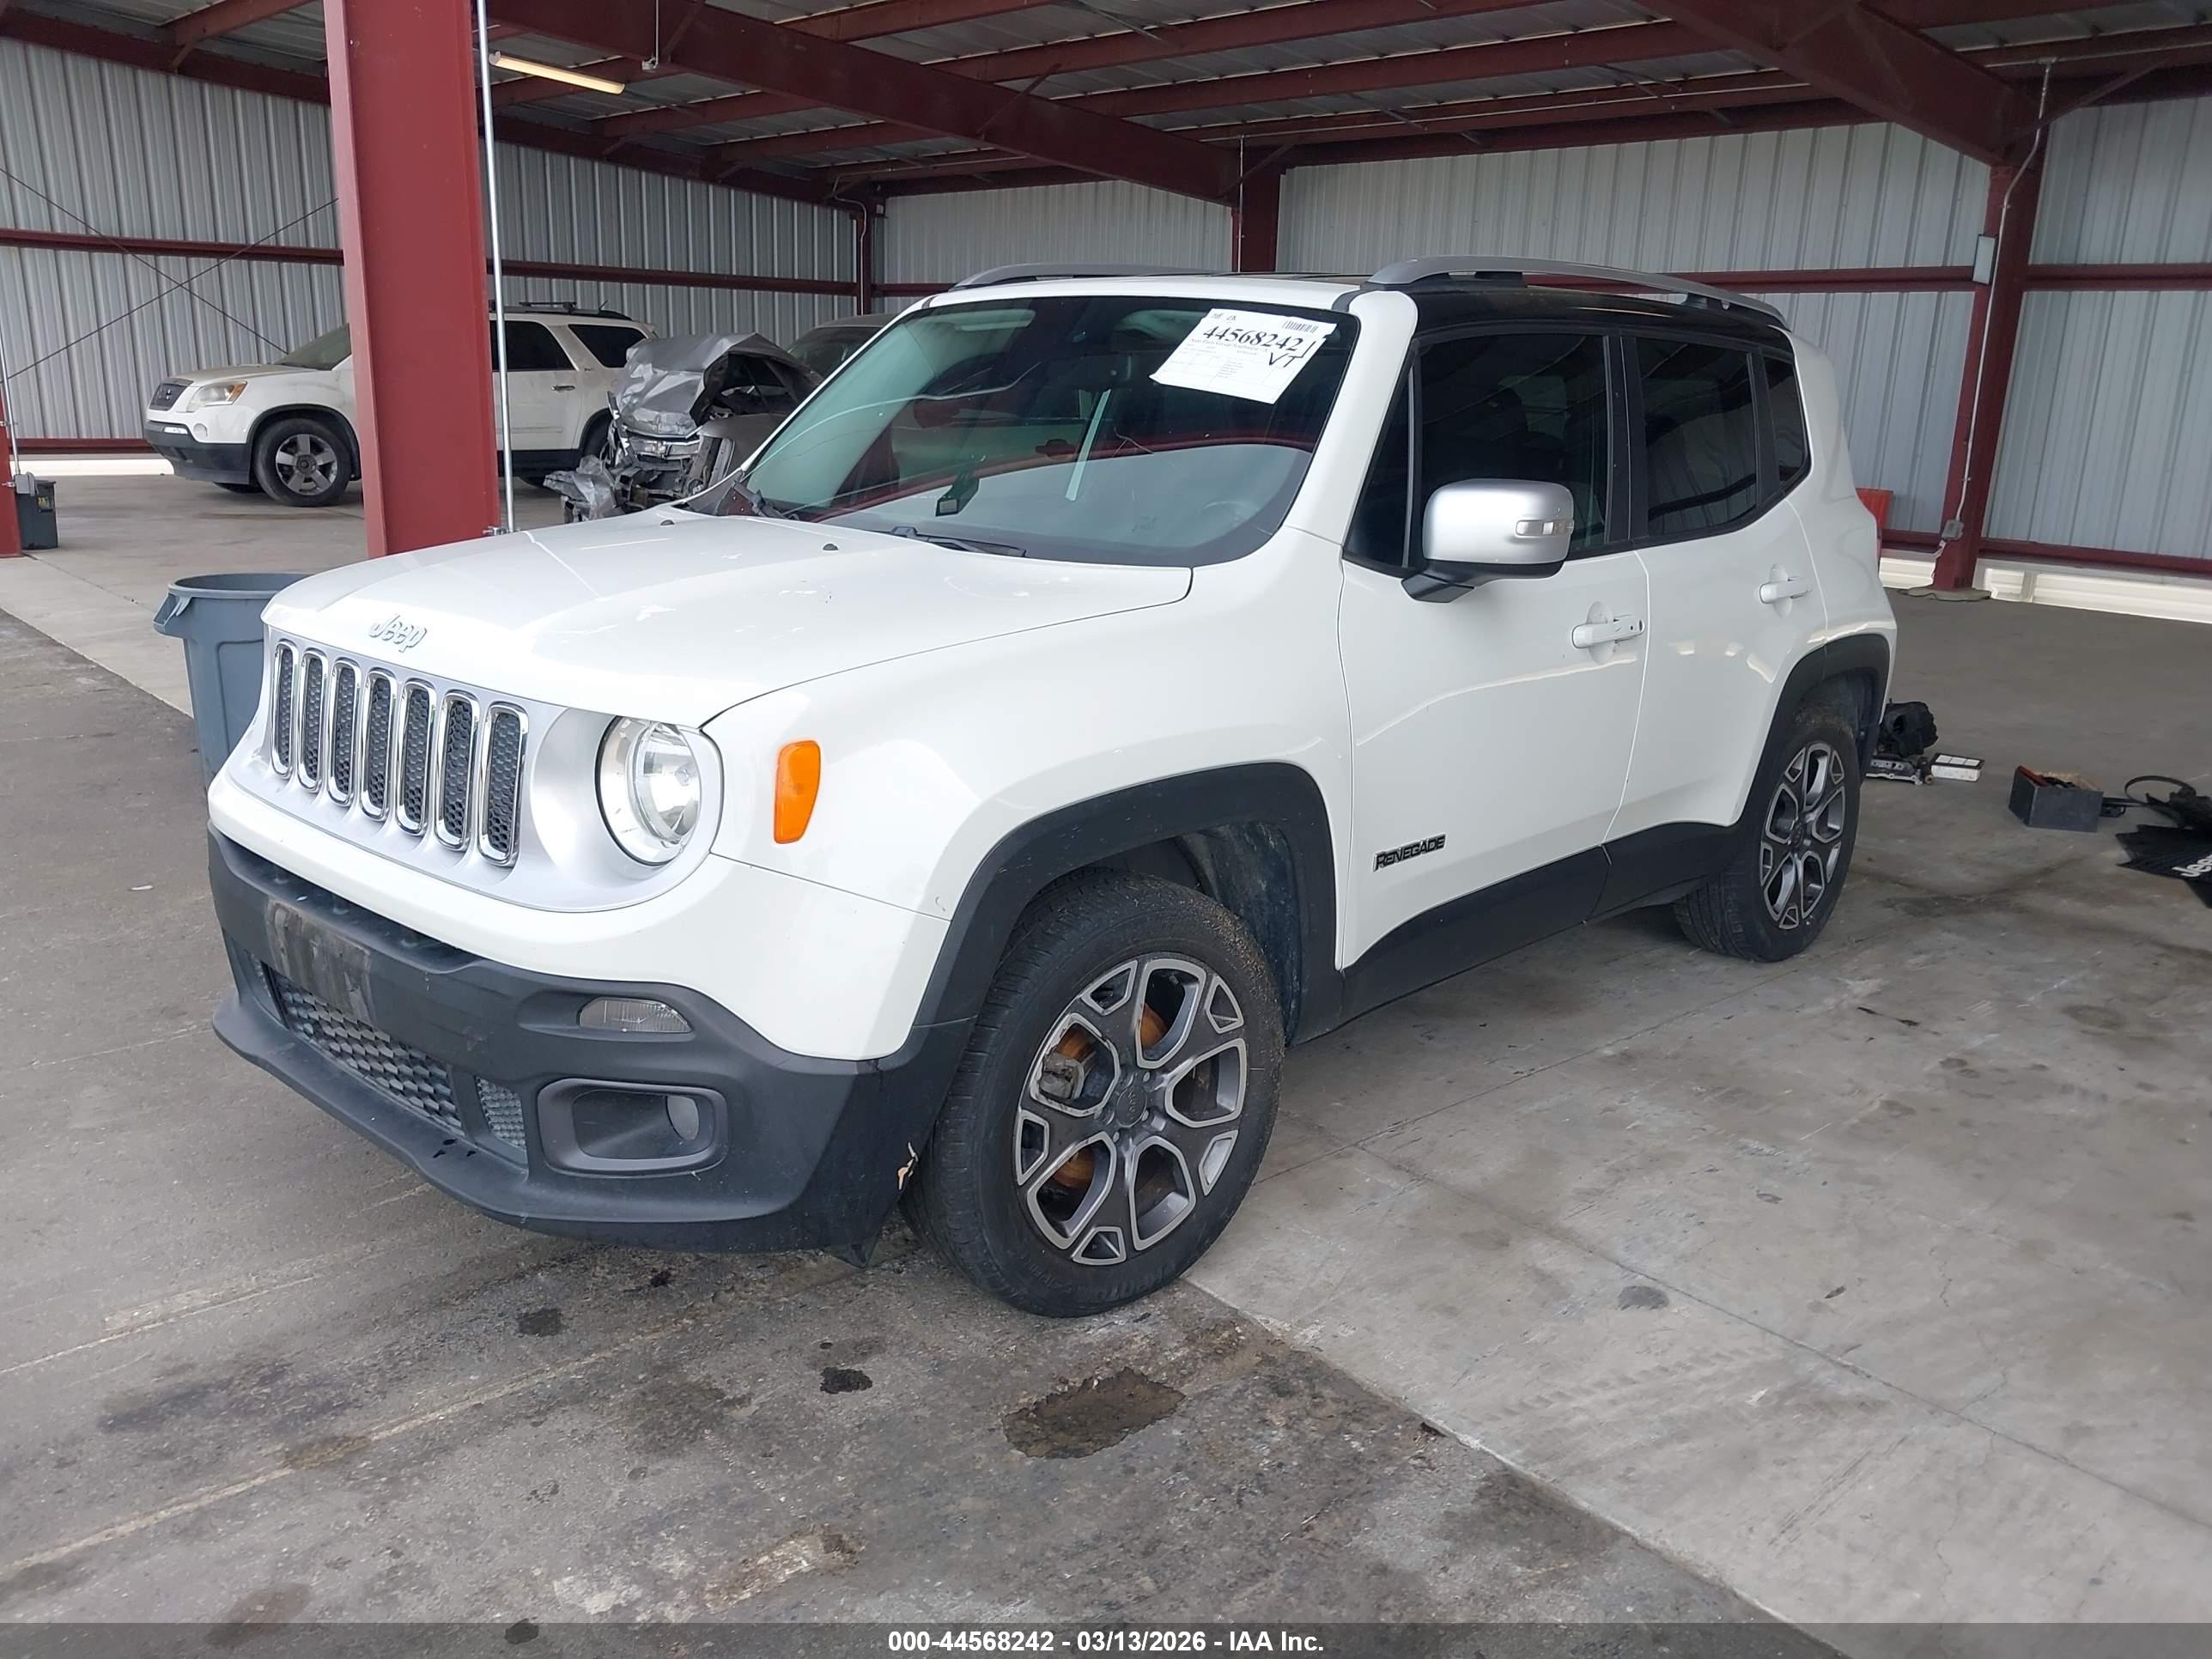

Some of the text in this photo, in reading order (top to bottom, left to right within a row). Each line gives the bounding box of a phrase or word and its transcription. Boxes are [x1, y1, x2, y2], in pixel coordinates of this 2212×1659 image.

[1203, 326, 1304, 351] 44568242
[368, 614, 428, 653] Jeep
[1373, 833, 1446, 872] RENEGADE
